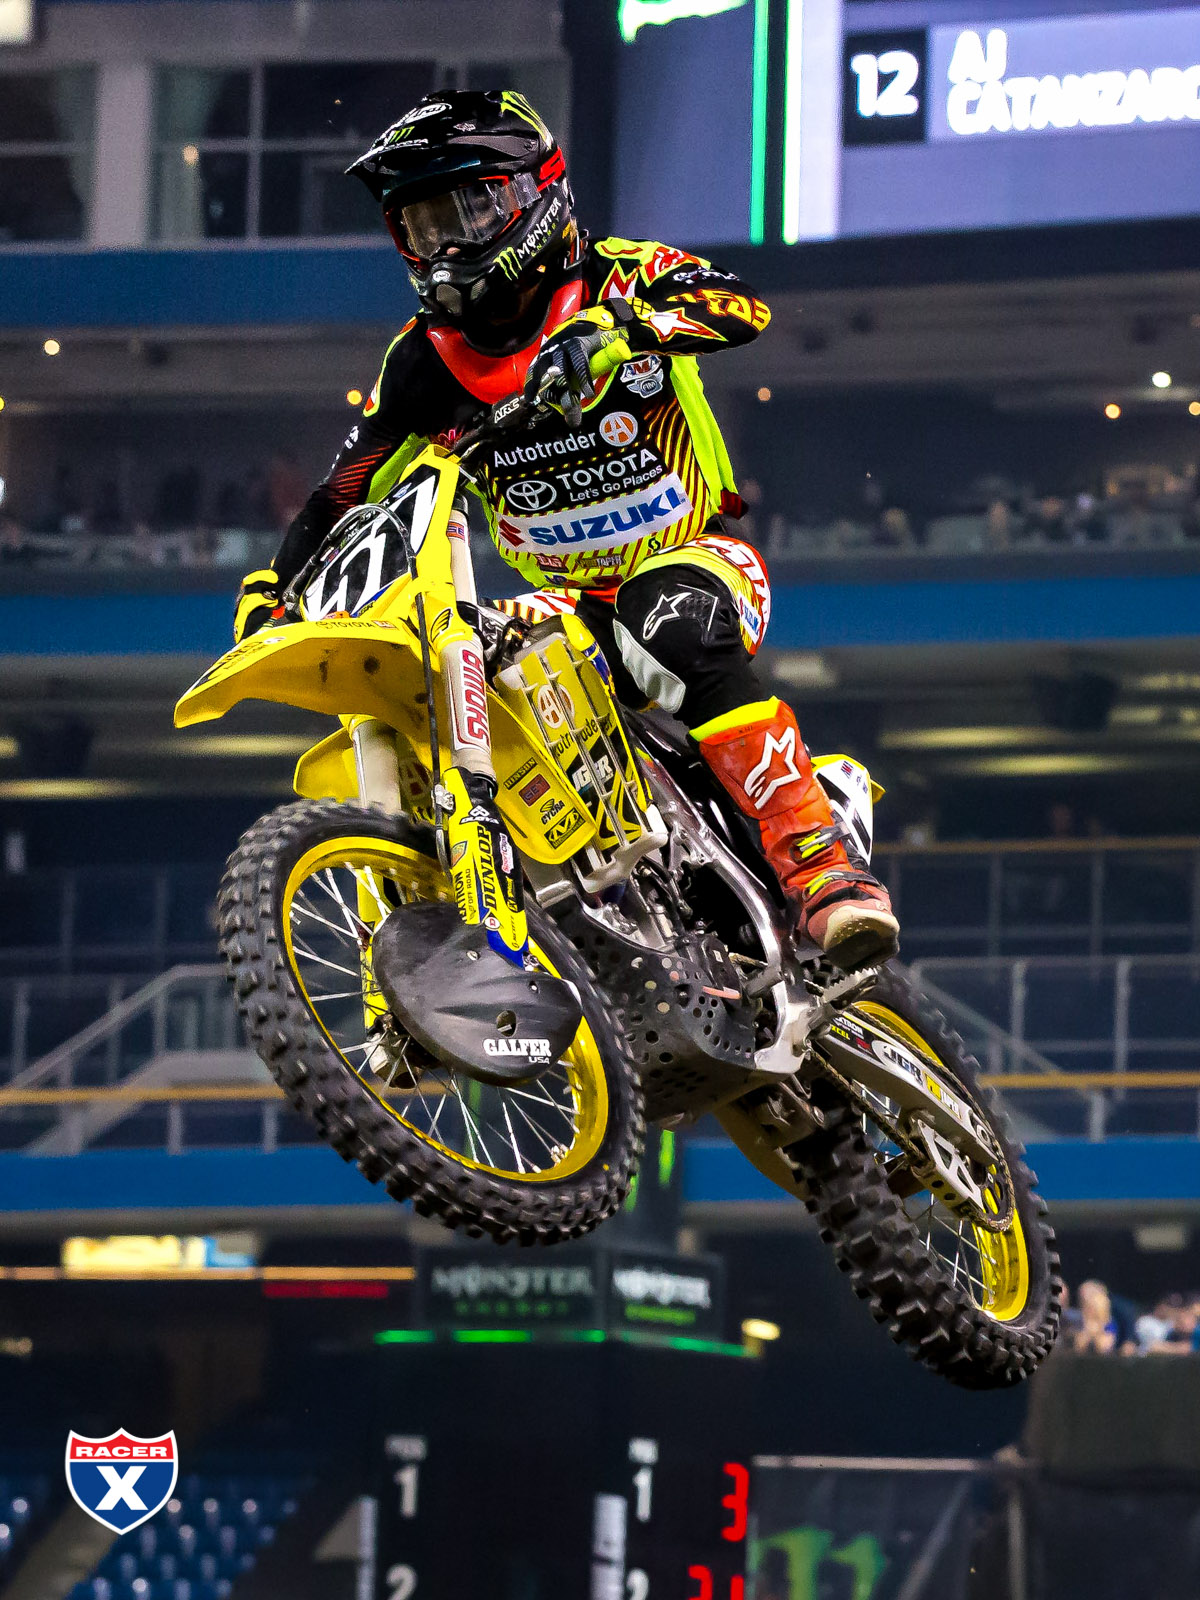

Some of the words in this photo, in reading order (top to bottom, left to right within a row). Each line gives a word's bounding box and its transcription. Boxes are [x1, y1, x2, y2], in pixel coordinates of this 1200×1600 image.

[851, 50, 920, 118] 12
[516, 197, 562, 259] MONSTER
[625, 354, 662, 377] AMA
[493, 430, 597, 469] Autotrader
[556, 448, 658, 491] TOYOTA
[569, 486, 600, 503] Let's
[601, 481, 622, 494] Go
[623, 464, 663, 487] Places
[528, 486, 685, 546] SUZUKI
[331, 621, 376, 629] TOYOTA
[461, 649, 490, 746] SHOWA
[541, 800, 565, 826] CYCRA
[477, 825, 498, 909] DUNLOP
[833, 1017, 864, 1036] XTRON
[482, 1038, 552, 1057] GALFER
[528, 1056, 550, 1065] USA
[883, 1045, 921, 1082] JGR
[394, 1465, 419, 1520] 1
[632, 1467, 653, 1523] 1
[720, 1462, 750, 1542] 3
